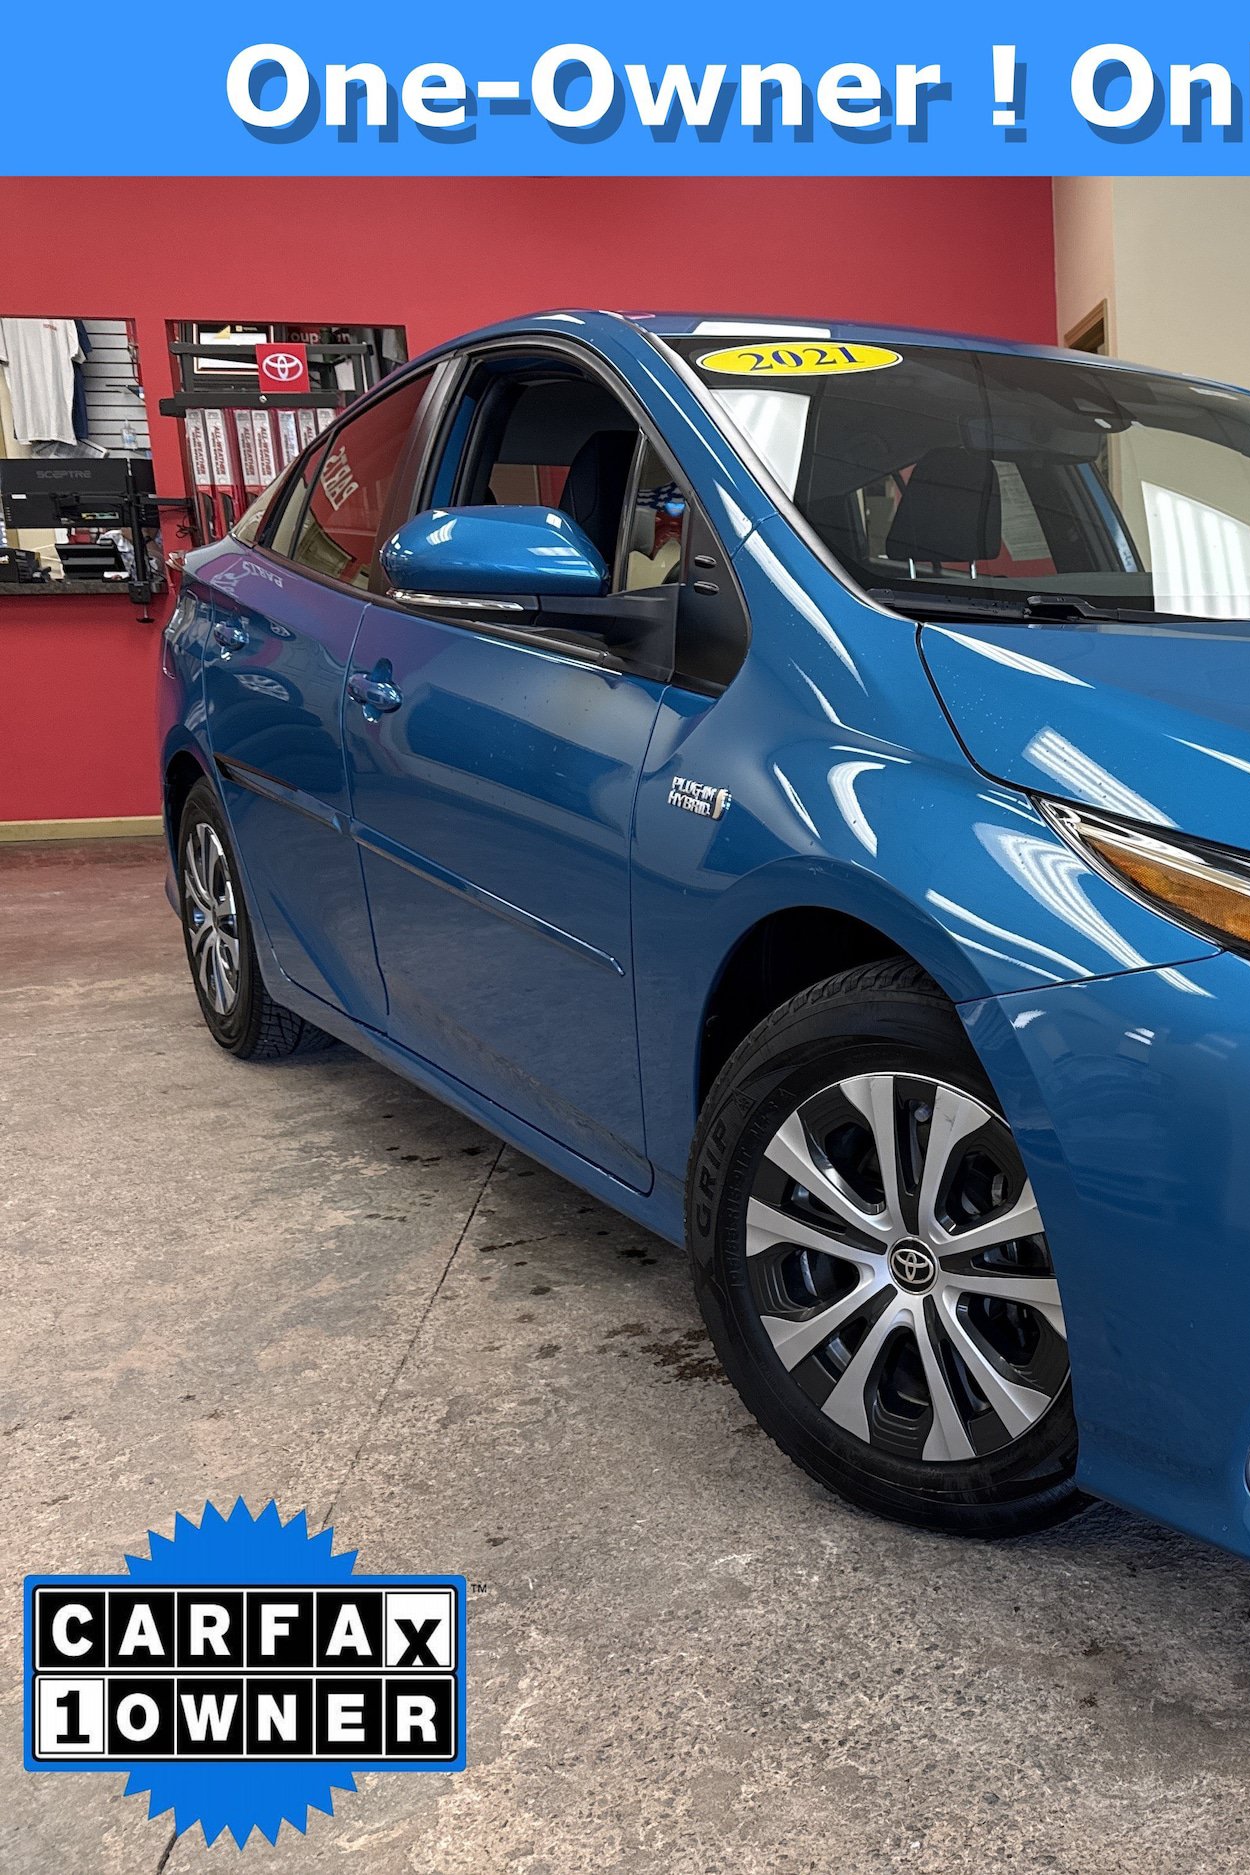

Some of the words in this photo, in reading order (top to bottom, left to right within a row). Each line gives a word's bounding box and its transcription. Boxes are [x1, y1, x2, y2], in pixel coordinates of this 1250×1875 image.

[737, 345, 865, 372] 2021
[36, 470, 92, 479] SCEPTRE
[671, 776, 718, 801] PLUG-IN
[667, 789, 711, 816] HYBRID
[696, 1117, 728, 1238] GRIP
